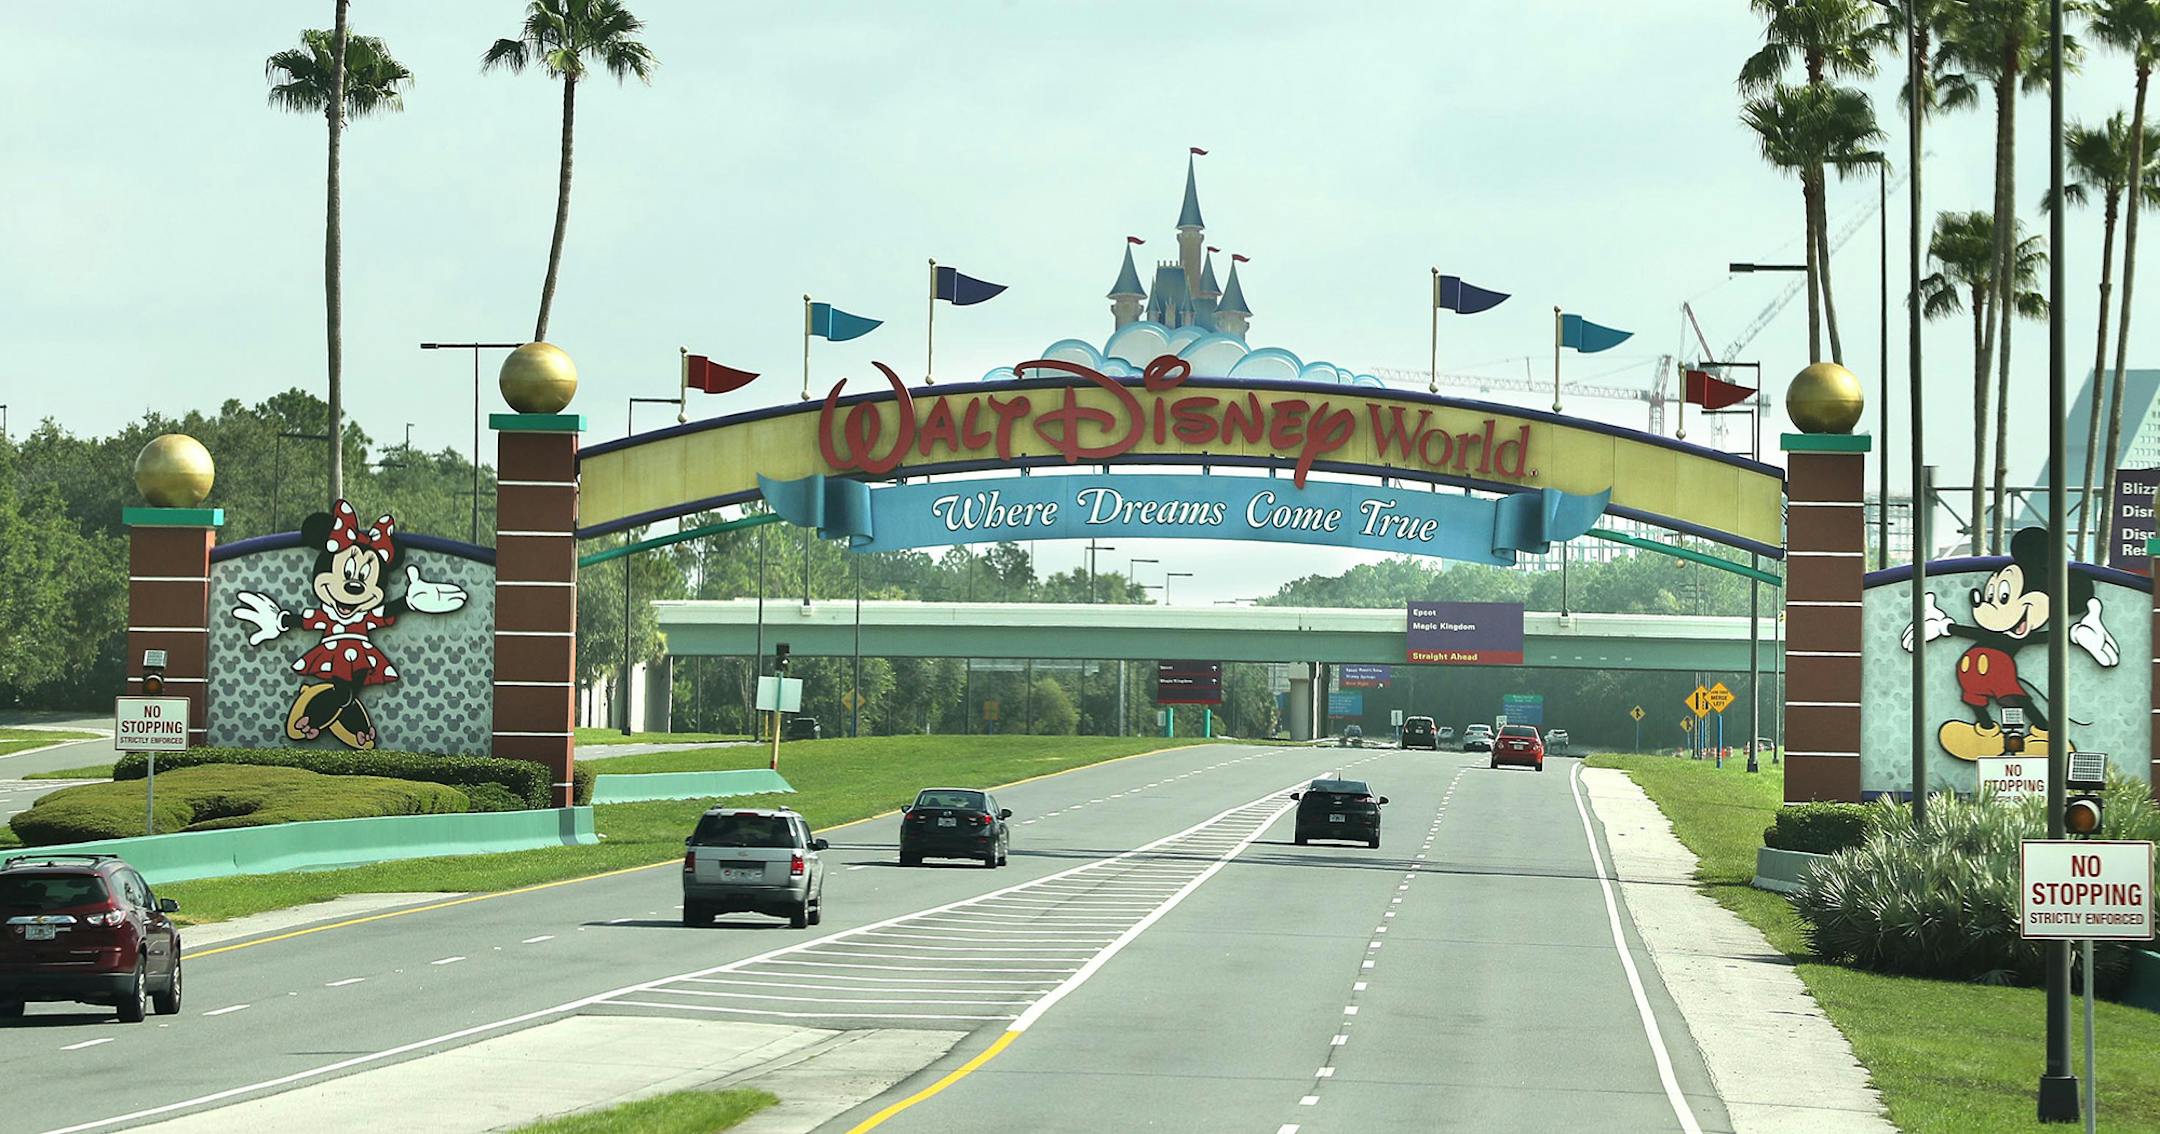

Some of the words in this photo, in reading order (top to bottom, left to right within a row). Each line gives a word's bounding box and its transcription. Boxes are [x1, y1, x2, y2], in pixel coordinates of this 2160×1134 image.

[932, 490, 1058, 531] Where
[1076, 487, 1227, 526] Dreams
[1245, 490, 1342, 532] Come
[1359, 499, 1438, 542] True
[1413, 608, 1437, 617] Epcot
[1413, 622, 1437, 631] Magic
[1440, 622, 1475, 631] Kingdom
[1413, 652, 1448, 661] Straight
[1450, 653, 1478, 661] Ahead
[144, 705, 161, 718] NO
[121, 720, 183, 734] STOPPING
[2005, 764, 2022, 777] NO
[2071, 855, 2102, 877] NO
[2031, 882, 2142, 906] STOPPING
[2030, 912, 2082, 924] STRICTLY
[2086, 913, 2145, 925] ENFORCED
